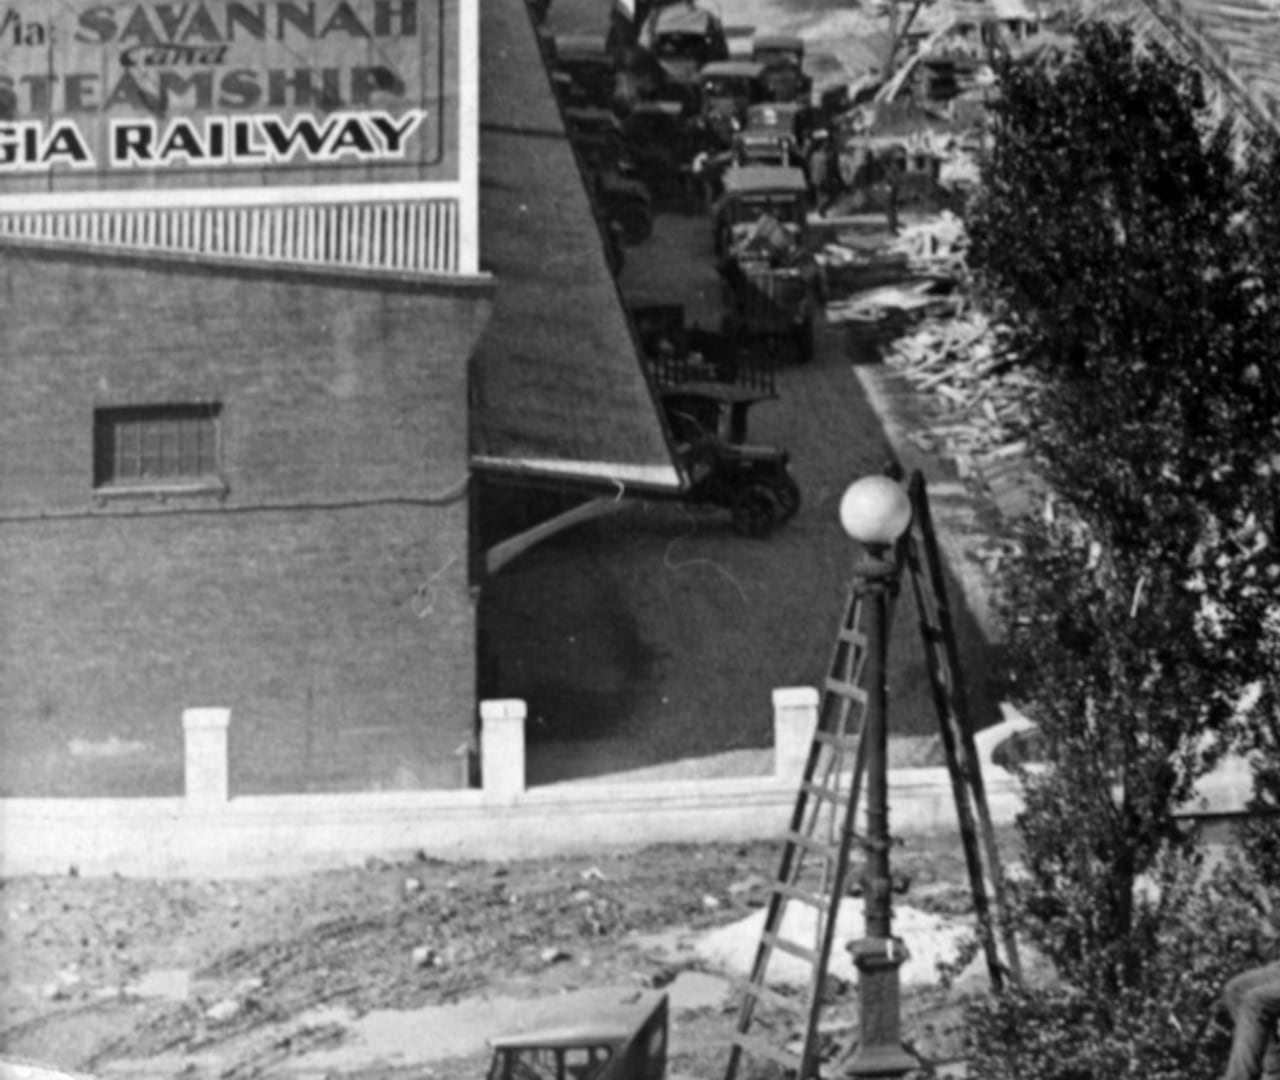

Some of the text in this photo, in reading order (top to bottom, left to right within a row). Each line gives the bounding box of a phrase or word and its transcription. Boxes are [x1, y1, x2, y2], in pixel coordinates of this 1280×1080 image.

[118, 42, 230, 69] and
[0, 66, 406, 118] STEAMSHIP
[110, 108, 428, 168] RAILWAY
